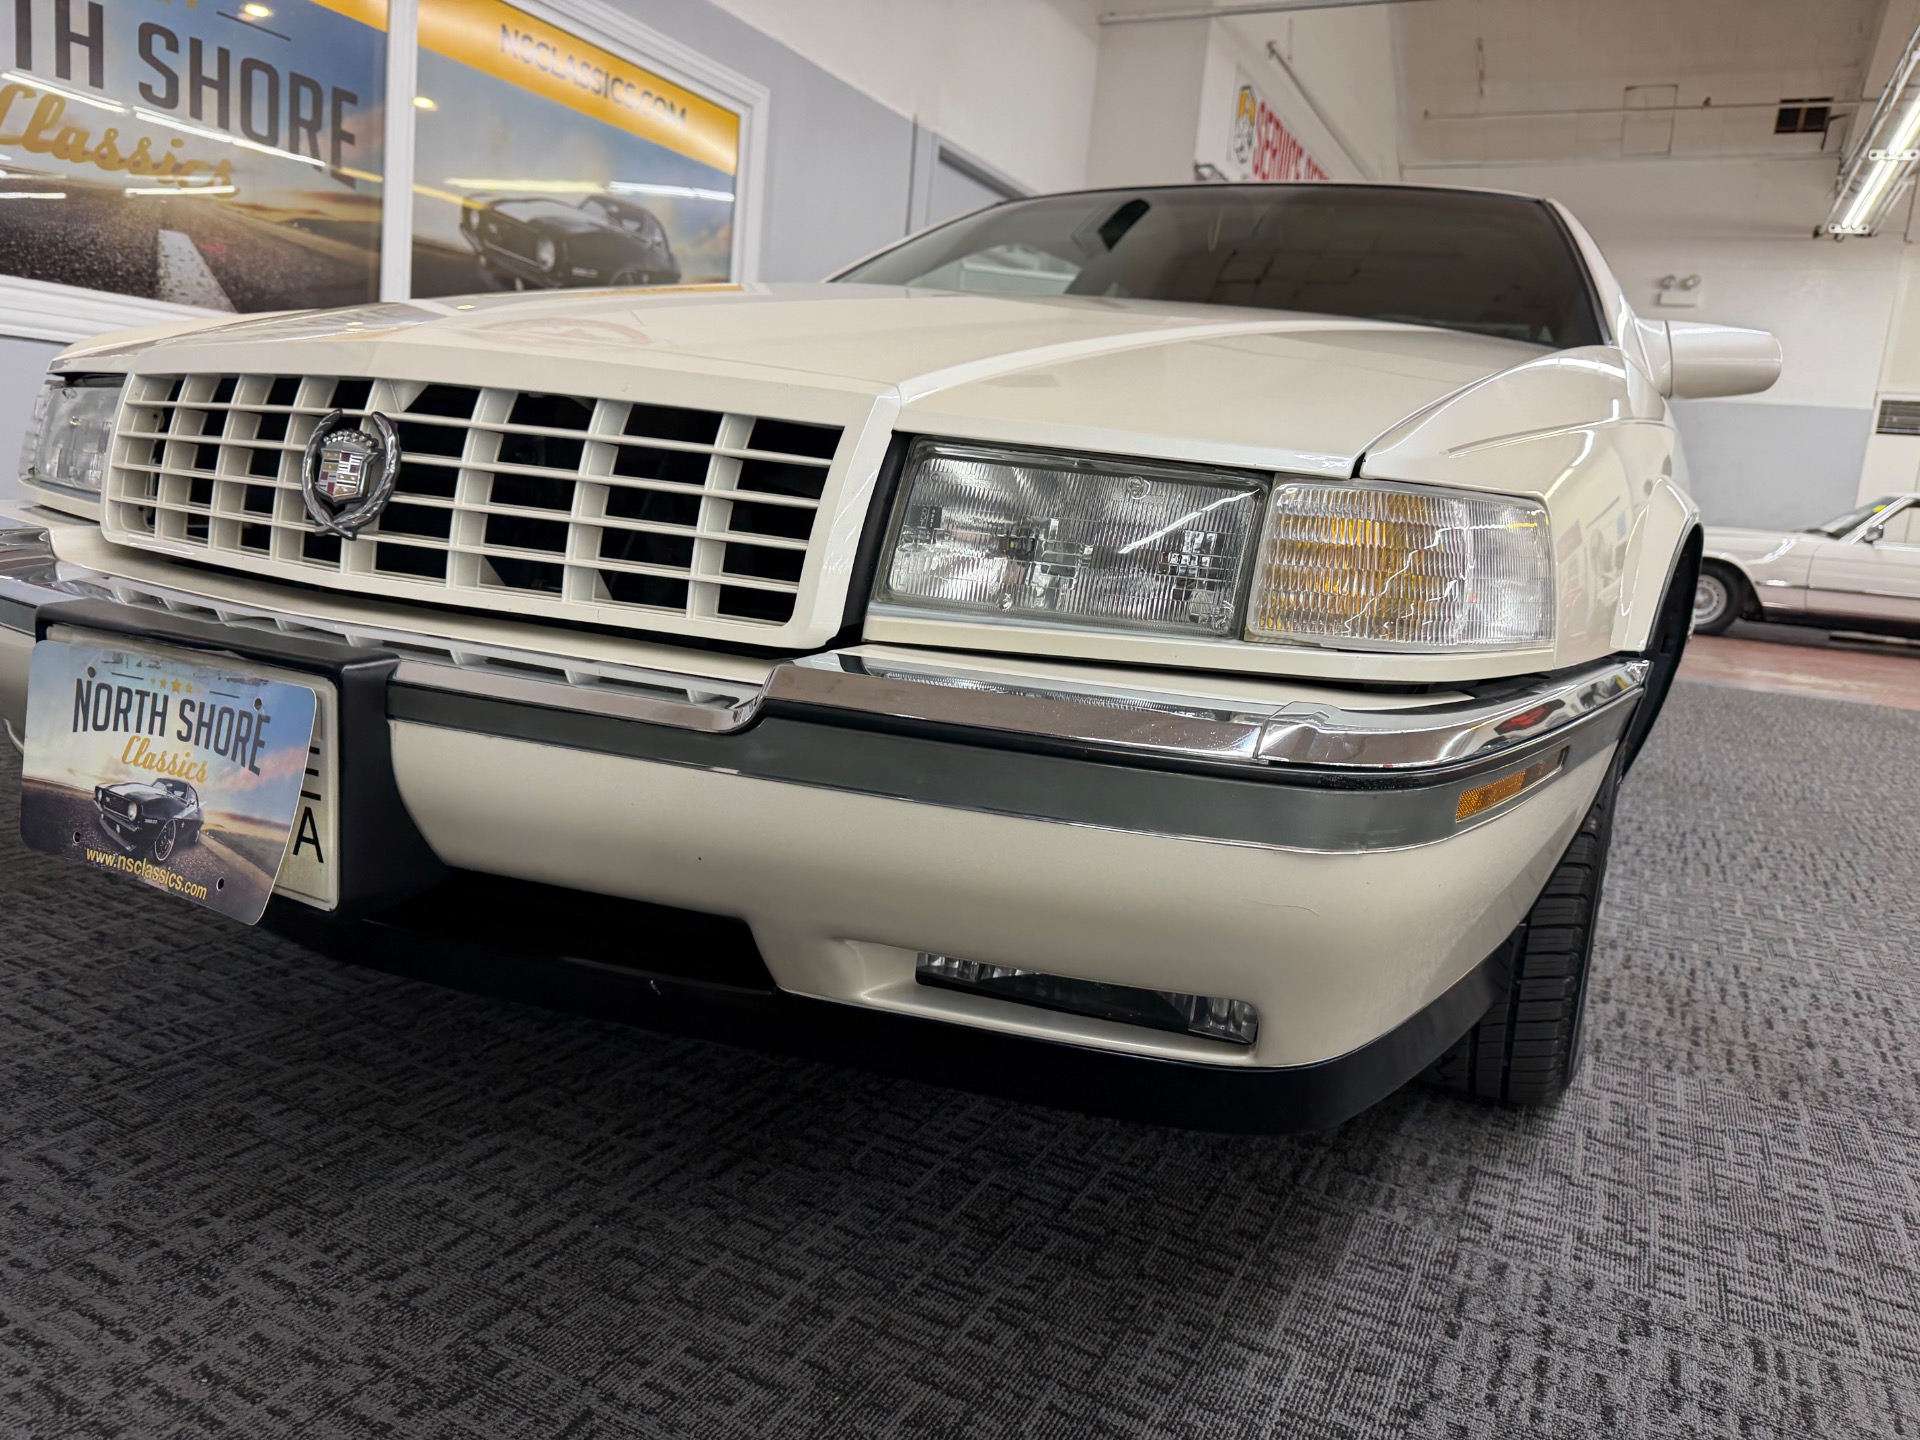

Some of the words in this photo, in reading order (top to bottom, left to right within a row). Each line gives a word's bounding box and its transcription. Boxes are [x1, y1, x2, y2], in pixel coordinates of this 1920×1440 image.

[137, 21, 358, 189] SHORE
[501, 23, 687, 128] NSCLASSICS.COM
[0, 83, 241, 198] Classics
[72, 677, 170, 737] NORTH
[176, 698, 271, 776] SHORE
[121, 735, 208, 783] Classics
[85, 847, 208, 900] www.nsclassics.com
